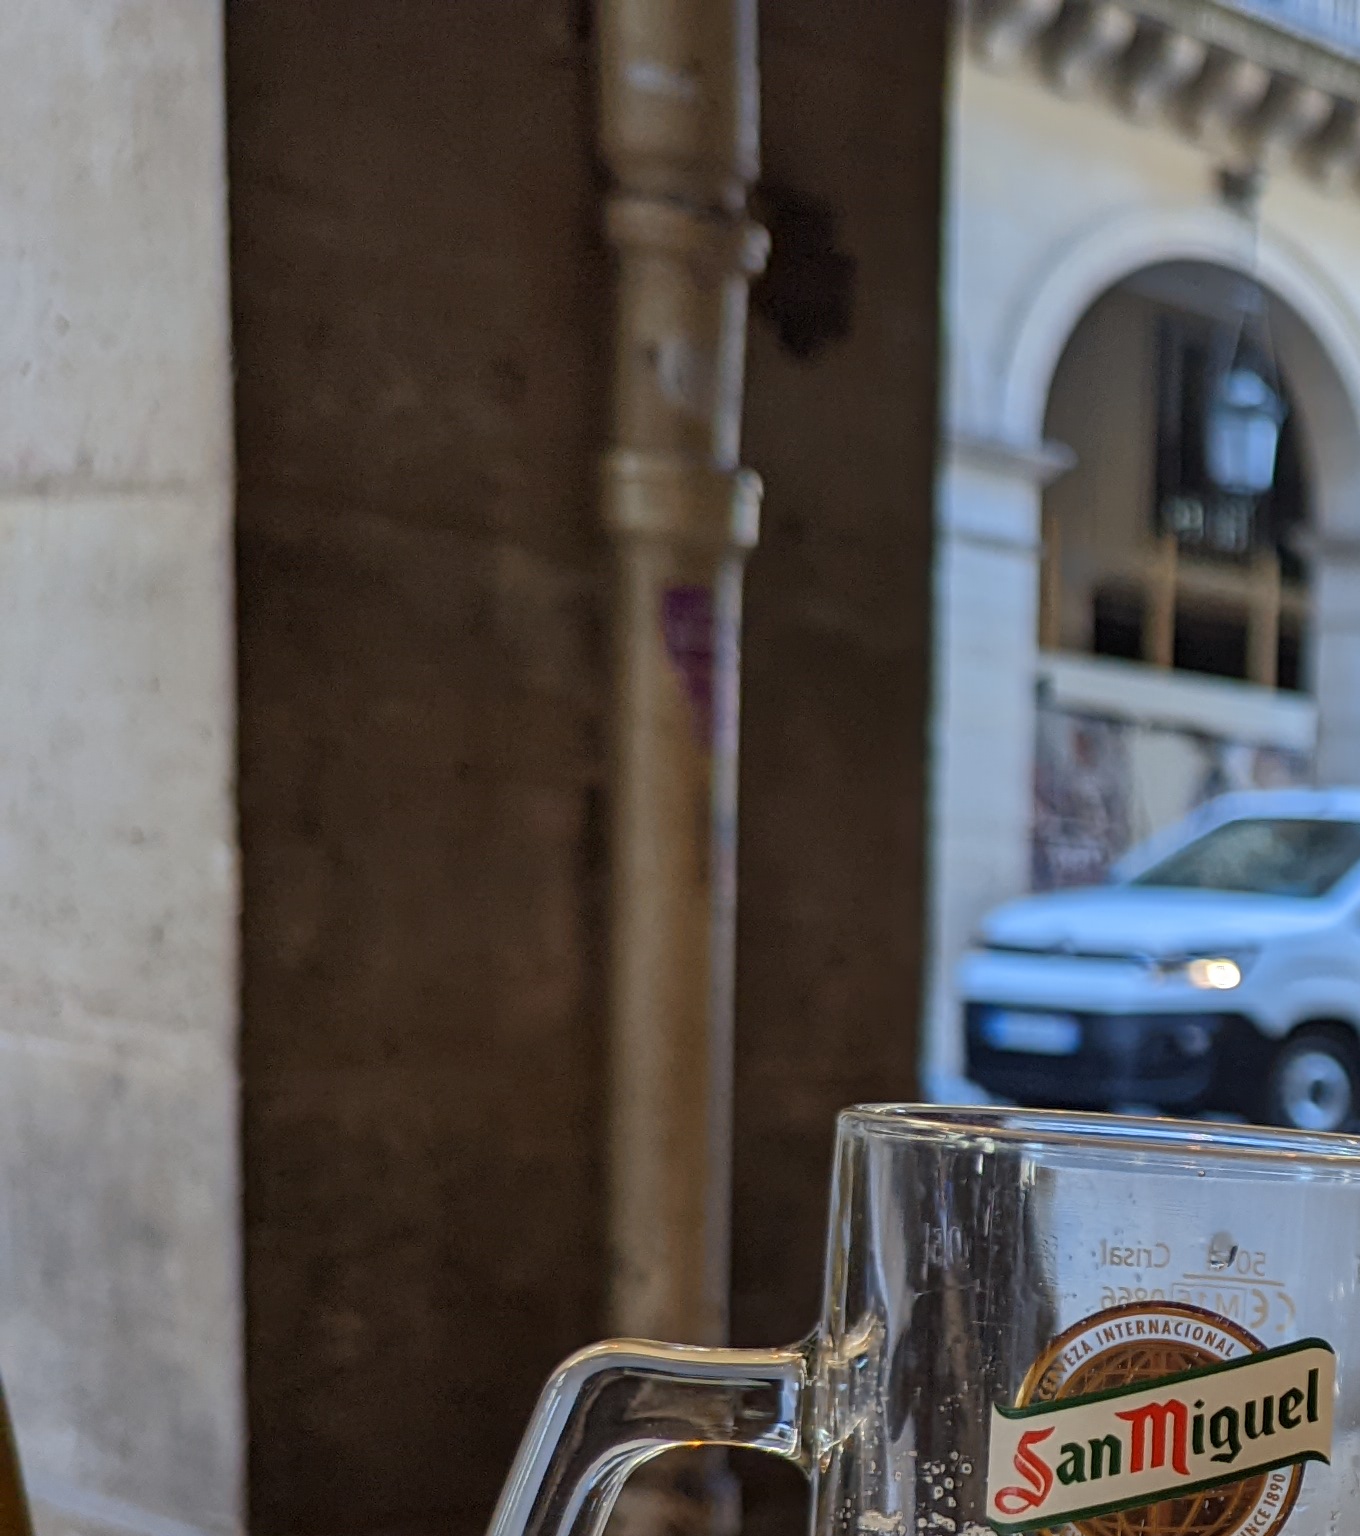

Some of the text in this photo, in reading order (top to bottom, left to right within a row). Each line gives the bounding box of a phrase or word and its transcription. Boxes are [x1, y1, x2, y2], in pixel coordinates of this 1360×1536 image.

[1095, 1318, 1237, 1358] INTERNACIONAL
[994, 1367, 1319, 1515] San Miguel
[1269, 1472, 1287, 1508] 1890
